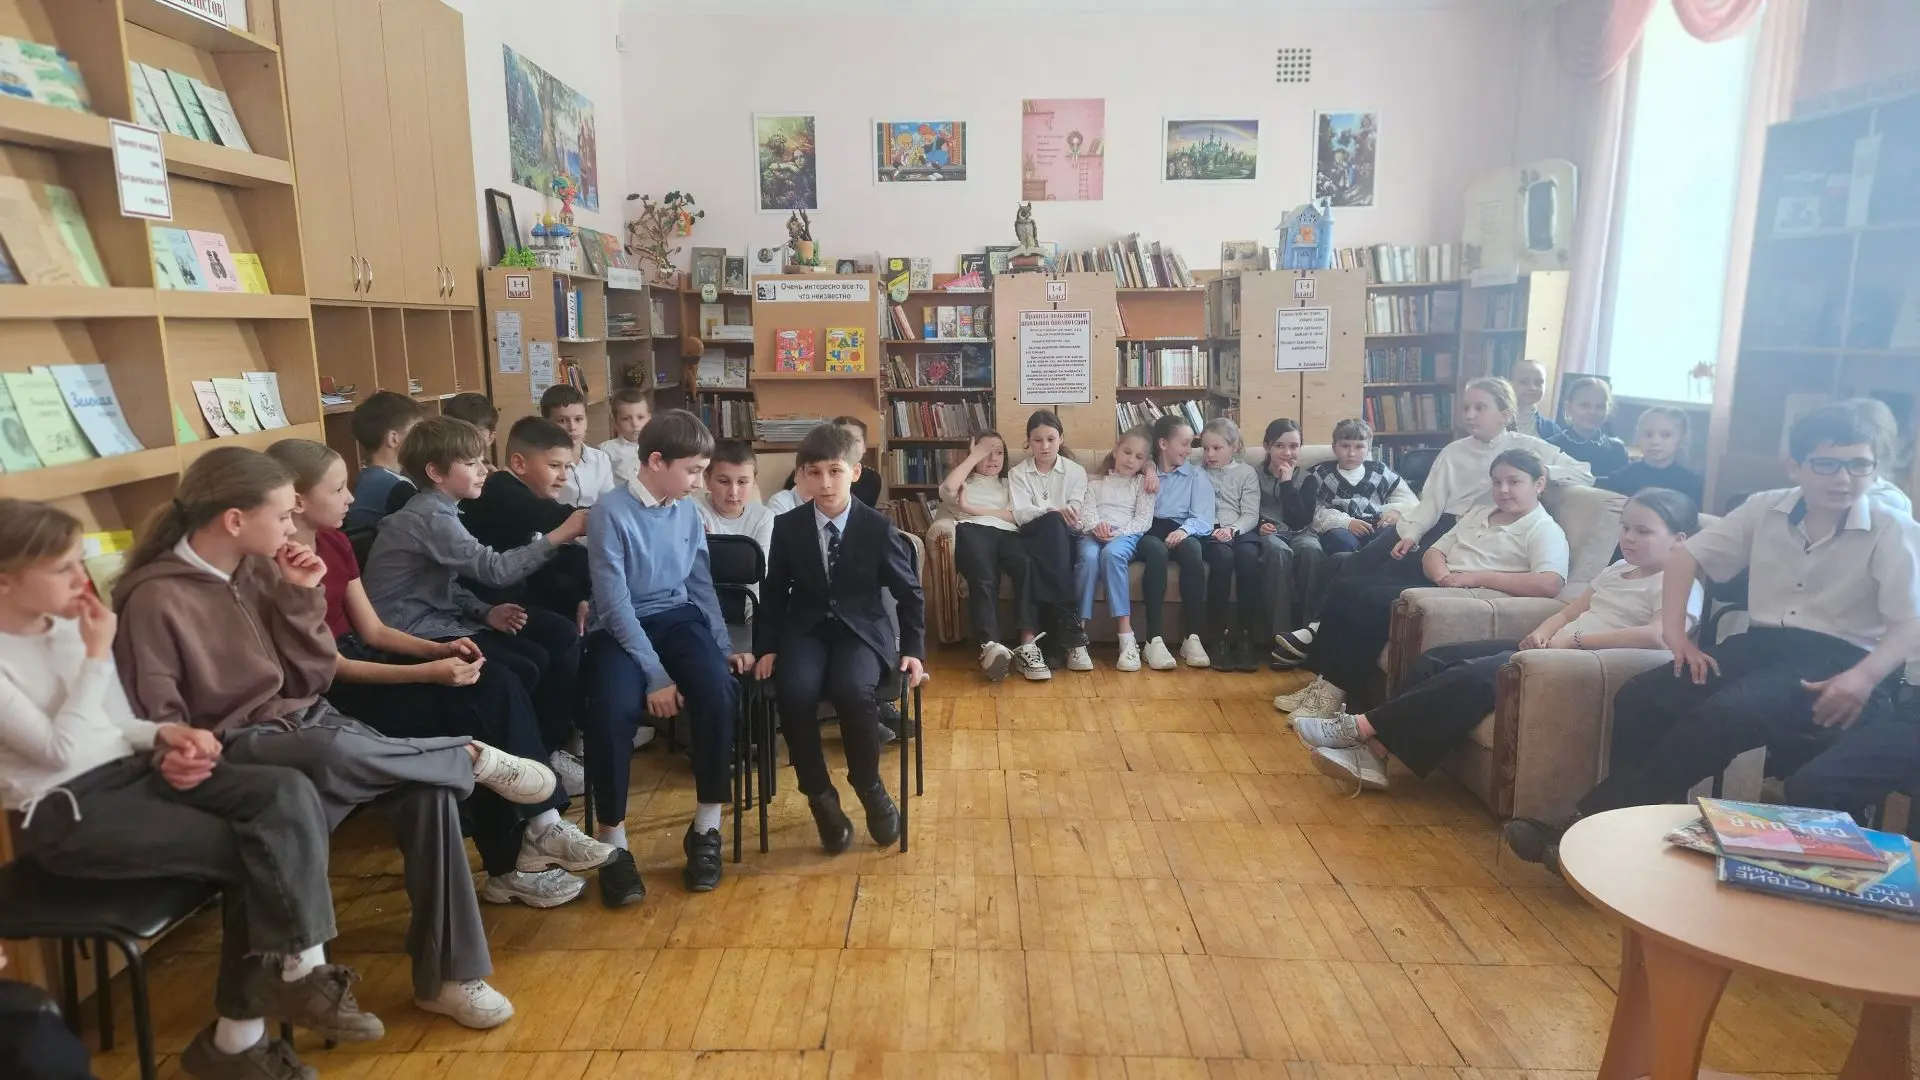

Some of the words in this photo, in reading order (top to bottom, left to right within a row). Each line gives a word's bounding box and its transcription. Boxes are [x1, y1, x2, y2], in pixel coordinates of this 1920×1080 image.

[780, 282, 802, 290] Очень
[804, 283, 840, 291] интересно
[1729, 817, 1849, 838] COLOUR
